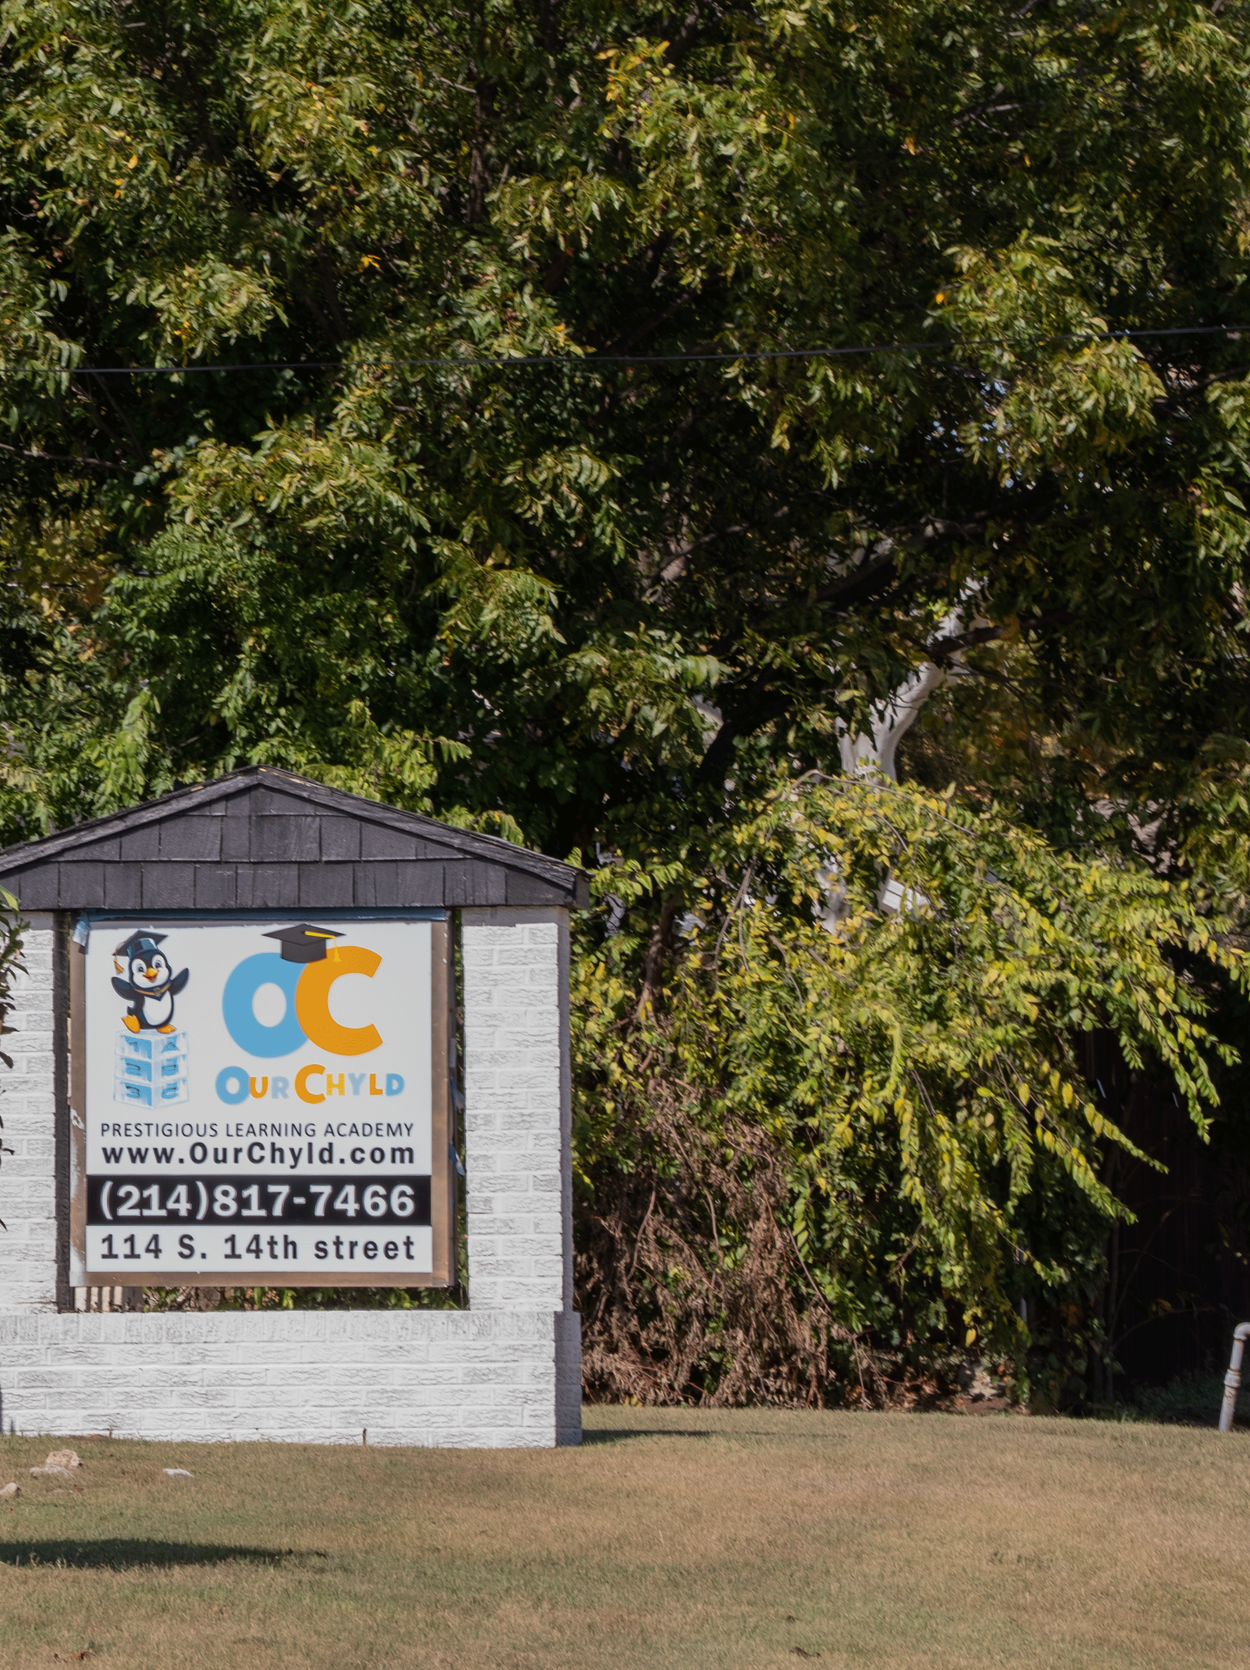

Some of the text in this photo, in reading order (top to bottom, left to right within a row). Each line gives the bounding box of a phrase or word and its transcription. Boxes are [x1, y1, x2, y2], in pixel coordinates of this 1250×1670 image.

[101, 1122, 414, 1138] PRESTIGIOUS LEARNING ACADEMY
[102, 1142, 415, 1169] www.OurChyld.com
[101, 1181, 415, 1220] (214)817-7466
[101, 1233, 415, 1261] 114 S. 14th street
